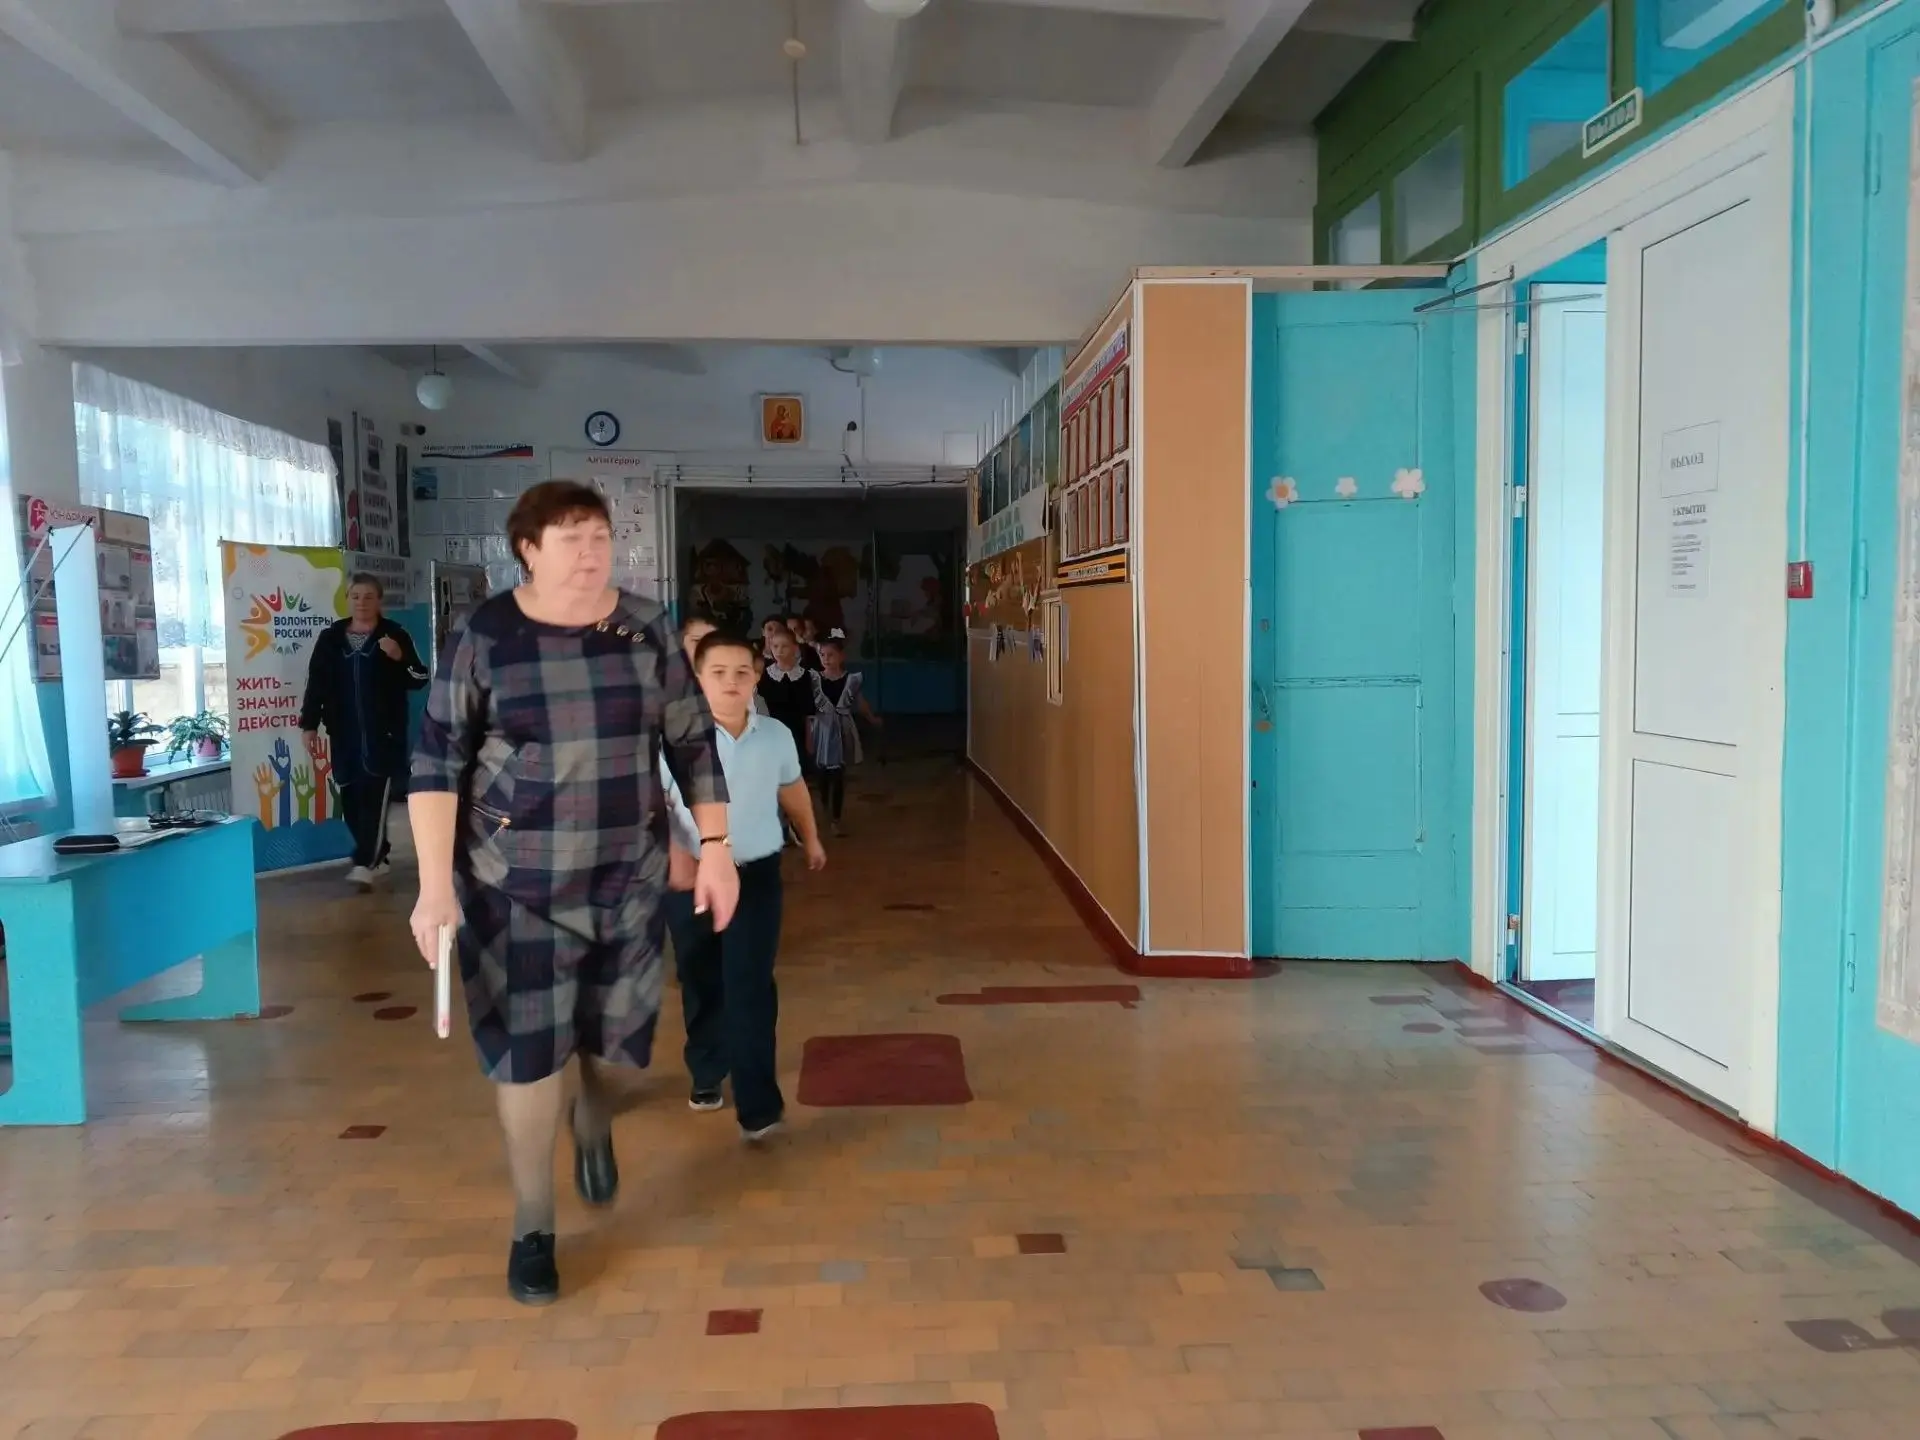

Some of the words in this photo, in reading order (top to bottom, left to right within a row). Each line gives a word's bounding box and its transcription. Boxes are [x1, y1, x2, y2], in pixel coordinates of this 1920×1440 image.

[1670, 452, 1704, 470] ВЫХОД
[273, 614, 333, 626] ВОЛОНТЁРЫ
[274, 629, 313, 638] РОССИИ
[236, 677, 282, 690] ЖИТЬ
[236, 695, 298, 710] ЗНАЧИТ
[237, 712, 304, 732] ДЕЙСТВ
